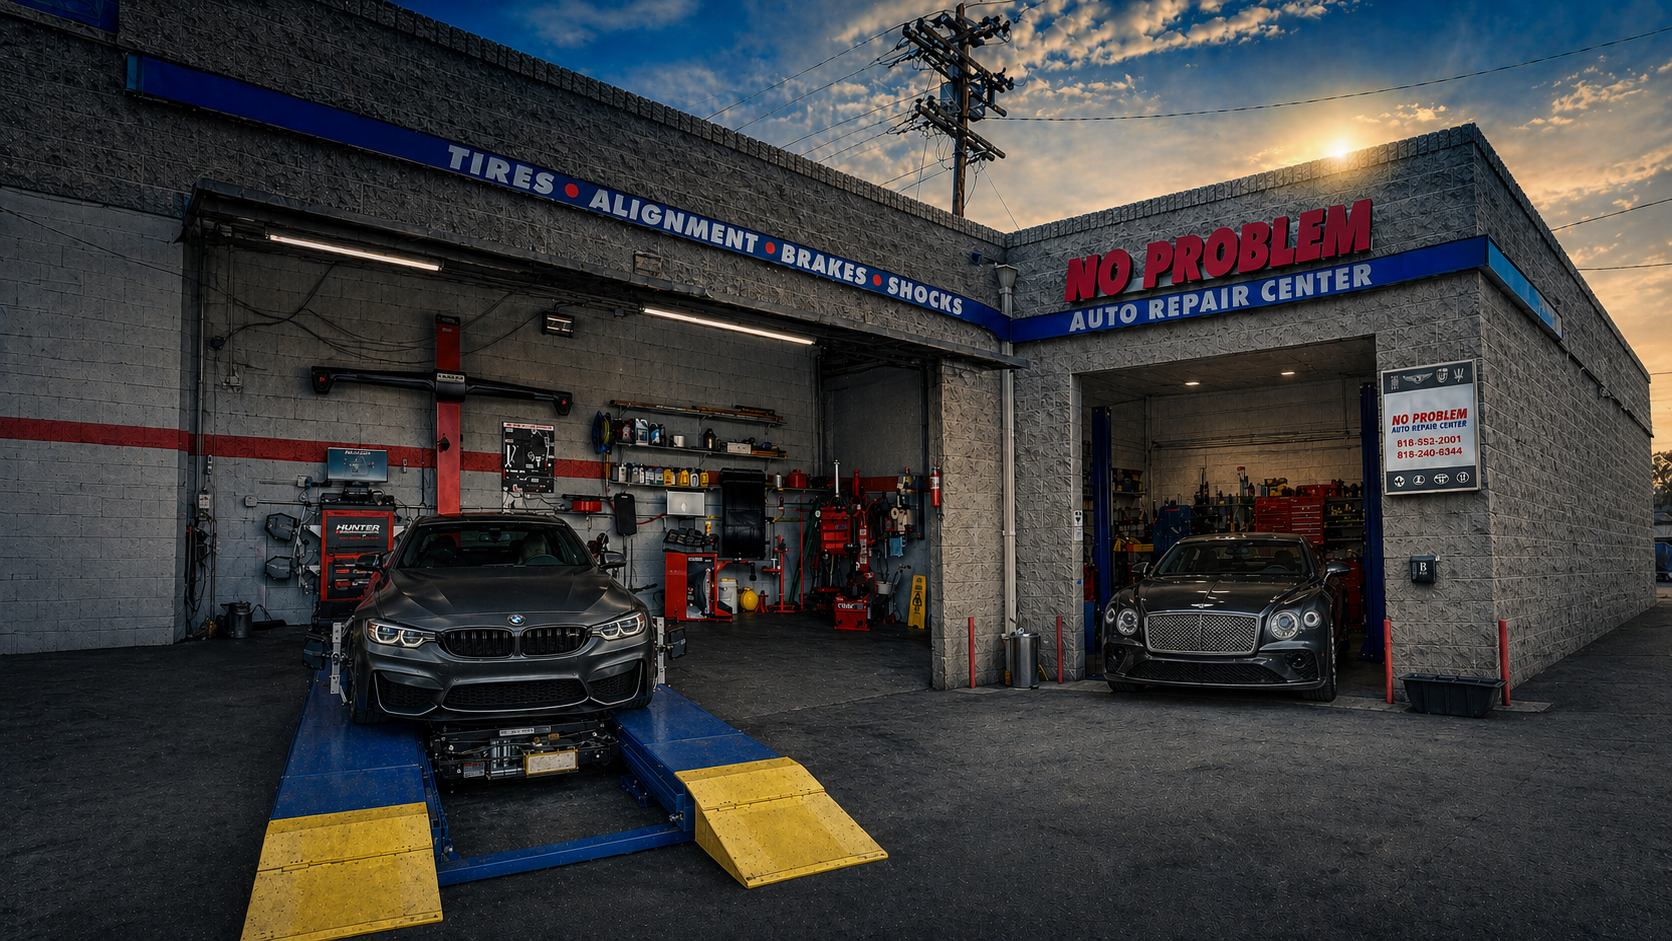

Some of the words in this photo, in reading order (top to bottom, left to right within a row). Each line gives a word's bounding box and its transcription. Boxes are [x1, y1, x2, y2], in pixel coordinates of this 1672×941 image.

[448, 144, 555, 195] TIRES
[589, 188, 759, 254] ALIGNMENT
[781, 243, 867, 285] BRAKES
[887, 276, 963, 315] SHOCKS
[1064, 248, 1132, 302] NO
[1143, 198, 1372, 289] PROBLEM
[1069, 303, 1138, 332] AUTO
[1149, 285, 1250, 320] REPAIR
[1261, 263, 1372, 302] CENTER
[1391, 424, 1410, 434] AUTO
[1392, 413, 1409, 426] NO
[1412, 408, 1468, 424] PROBLEM
